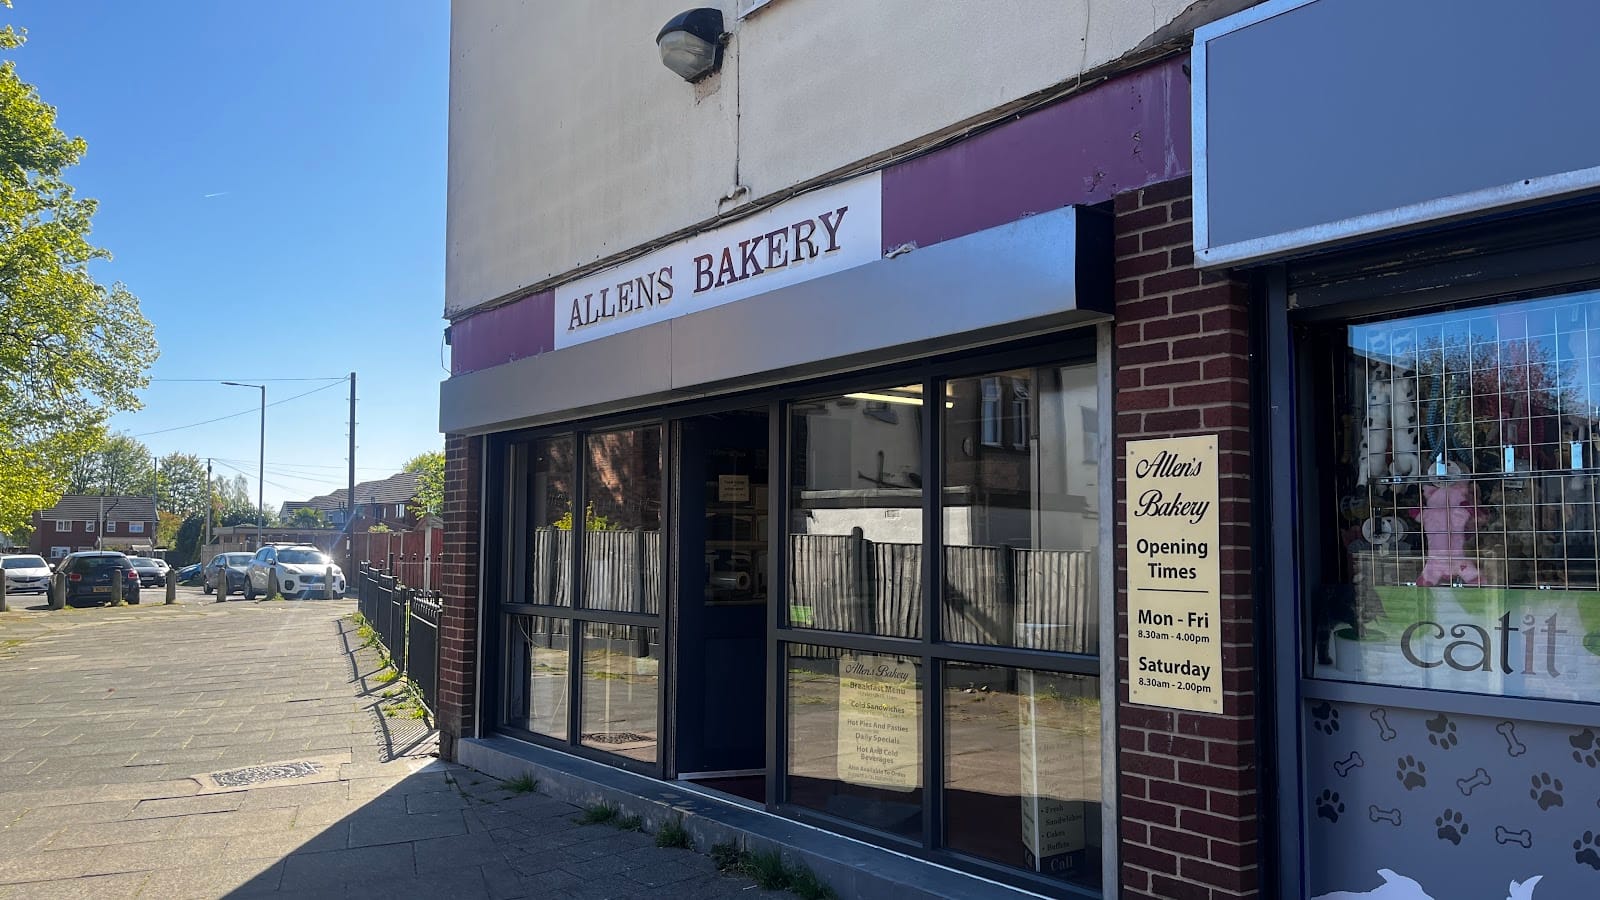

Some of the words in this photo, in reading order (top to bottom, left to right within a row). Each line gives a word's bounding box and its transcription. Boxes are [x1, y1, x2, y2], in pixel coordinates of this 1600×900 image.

[567, 265, 674, 331] ALLENS
[693, 205, 849, 294] BAKERY
[1135, 450, 1203, 479] Allen's
[1134, 489, 1210, 525] Bakery
[1136, 538, 1208, 559] Opening
[1147, 562, 1197, 580] Times
[1138, 609, 1173, 627] Mon
[1187, 612, 1209, 628] Fri
[1137, 630, 1169, 640] 8.30am
[1175, 632, 1210, 644] 4.00pm
[1400, 610, 1568, 679] catit
[876, 664, 909, 682] Bakery
[1138, 656, 1211, 681] Saturday
[849, 681, 884, 692] Breakfast
[885, 685, 906, 695] Menu
[1138, 677, 1170, 689] 8.30am
[1177, 681, 1212, 694] 2.00pm
[851, 701, 866, 709] Cold
[866, 702, 905, 714] Sandwiches
[859, 720, 872, 728] Pies
[873, 721, 886, 729] And
[886, 724, 909, 733] Pasties
[855, 733, 872, 743] Daily
[873, 734, 900, 745] Specials
[856, 745, 868, 753] Hot
[869, 747, 883, 755] And
[883, 749, 898, 757] Cold
[860, 755, 894, 765] Beverages
[1045, 805, 1064, 814] Fresh
[1046, 814, 1082, 825] Sandwiches
[1046, 830, 1065, 838] Cakes
[1050, 855, 1073, 872] Call
